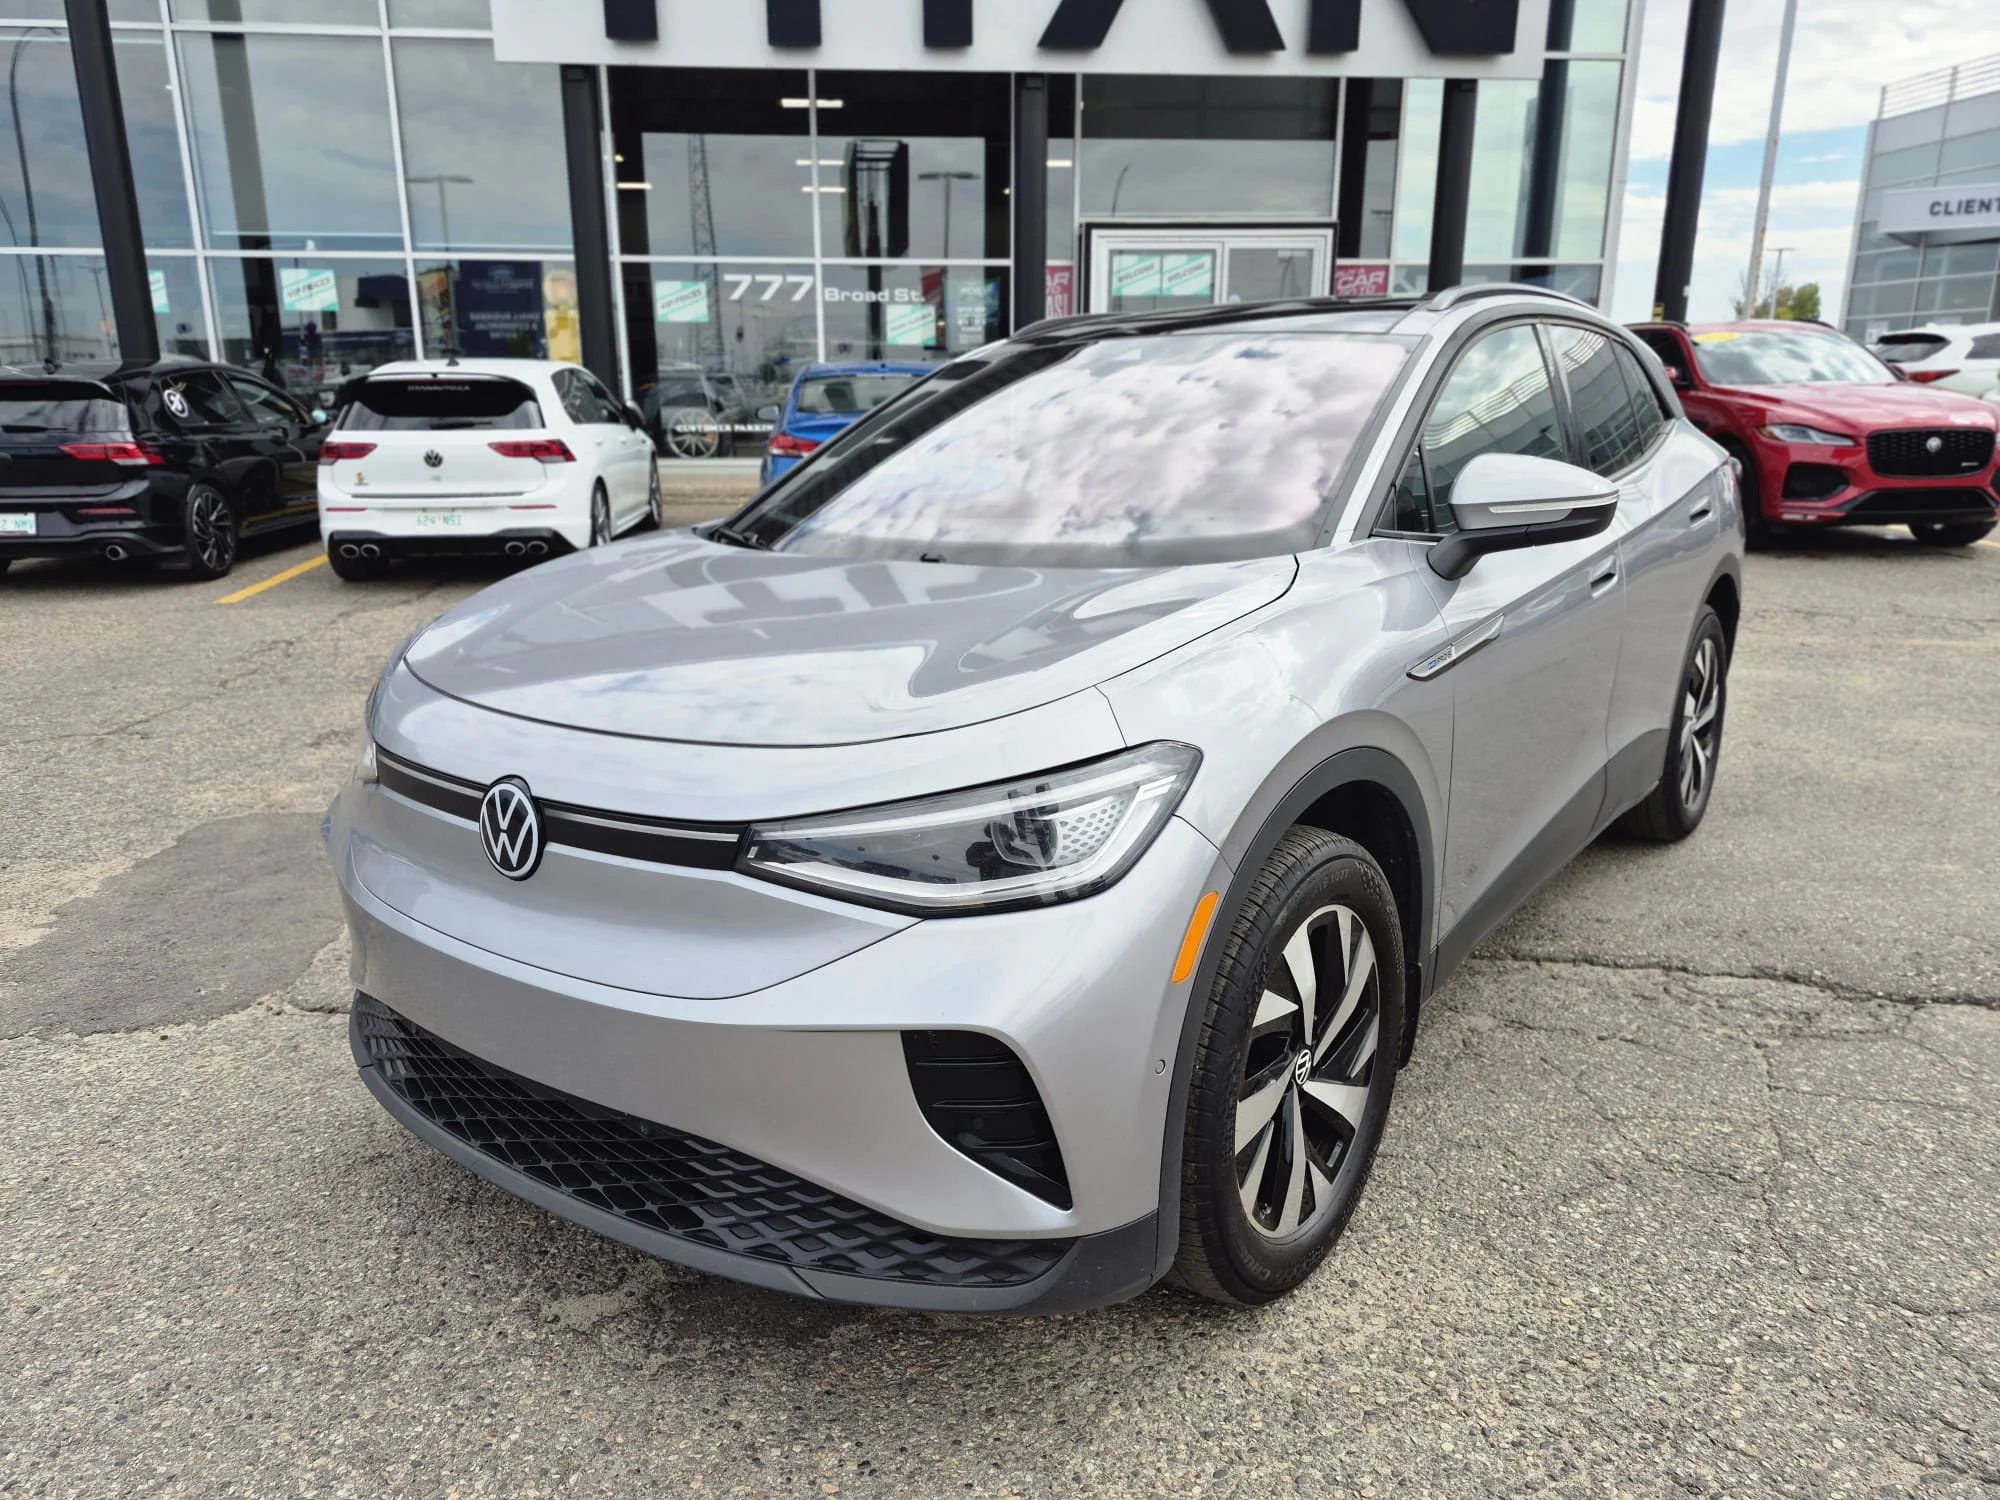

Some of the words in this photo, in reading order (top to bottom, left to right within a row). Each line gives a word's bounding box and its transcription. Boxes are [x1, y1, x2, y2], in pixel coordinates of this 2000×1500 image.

[1118, 263, 1154, 283] WELCOME
[1168, 262, 1205, 282] WELCOME
[1338, 271, 1385, 291] CAR
[287, 286, 300, 299] VIP
[724, 274, 814, 302] 777
[824, 288, 889, 302] Broad
[894, 288, 926, 302] St.
[676, 424, 732, 432] CUSTOMER
[734, 424, 774, 432] PARKIN
[480, 783, 539, 878] VW
